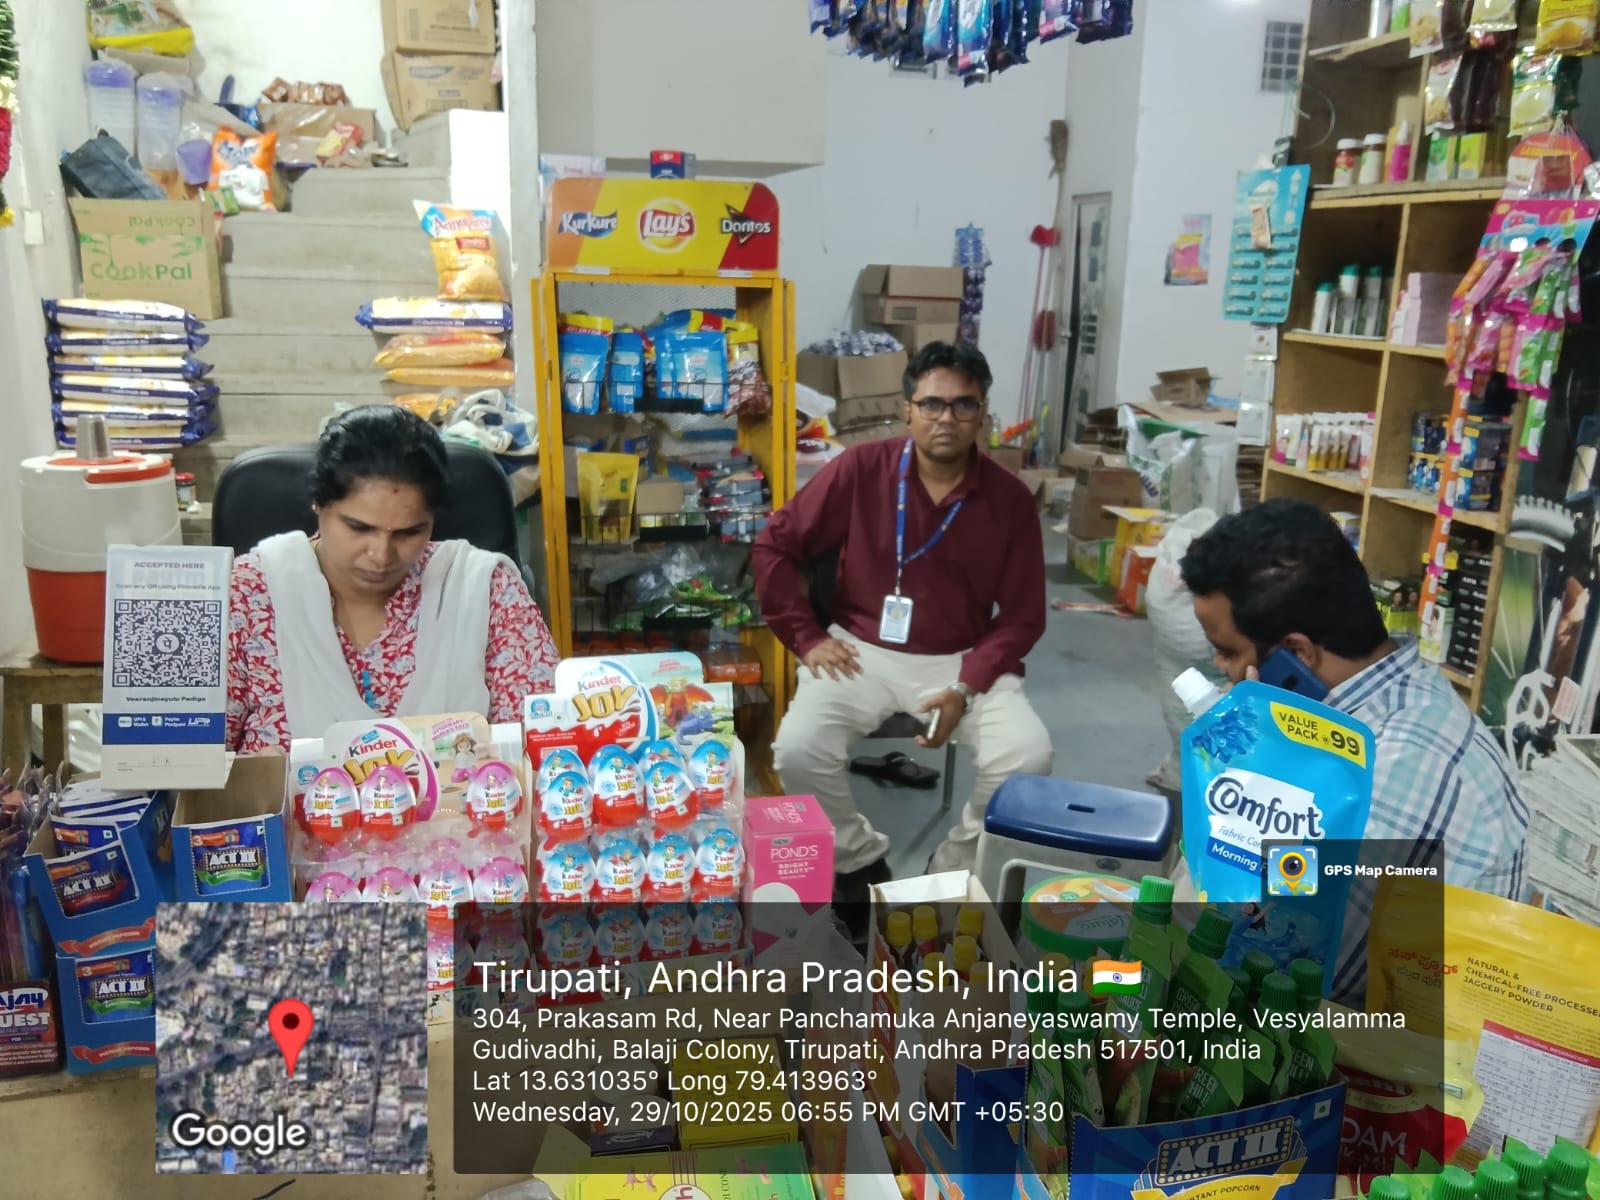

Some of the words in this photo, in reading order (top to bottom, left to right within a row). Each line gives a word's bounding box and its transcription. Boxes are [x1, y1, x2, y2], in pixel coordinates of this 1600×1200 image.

[560, 209, 617, 236] Kurkure
[721, 218, 772, 235] Doritos
[90, 262, 193, 281] CookPal
[577, 674, 623, 692] Kinder
[1279, 711, 1319, 731] VALUE
[1287, 724, 1319, 742] PACK
[348, 738, 399, 758] Kinder
[1330, 730, 1360, 756] 99
[1208, 776, 1322, 838] Comfort
[1218, 825, 1246, 845] Fabric
[209, 852, 237, 866] ACT
[239, 851, 257, 863] II
[771, 845, 818, 860] POND'S
[1211, 843, 1258, 873] Morning
[779, 861, 809, 869] BRIGHT
[64, 877, 92, 896] ACT
[1467, 956, 1511, 978] NATURAL
[98, 982, 127, 995] ACT
[127, 979, 146, 992] II
[1463, 975, 1507, 996] JAGGERY
[1508, 991, 1554, 1013] POWDER
[1465, 966, 1542, 998] CHEMICAL-FREE
[1544, 993, 1600, 1018] PROCESSE
[0, 1012, 50, 1028] UEST
[1168, 1137, 1240, 1176] ACT
[1240, 1126, 1282, 1161] II
[1220, 1185, 1261, 1194] POPCORN
